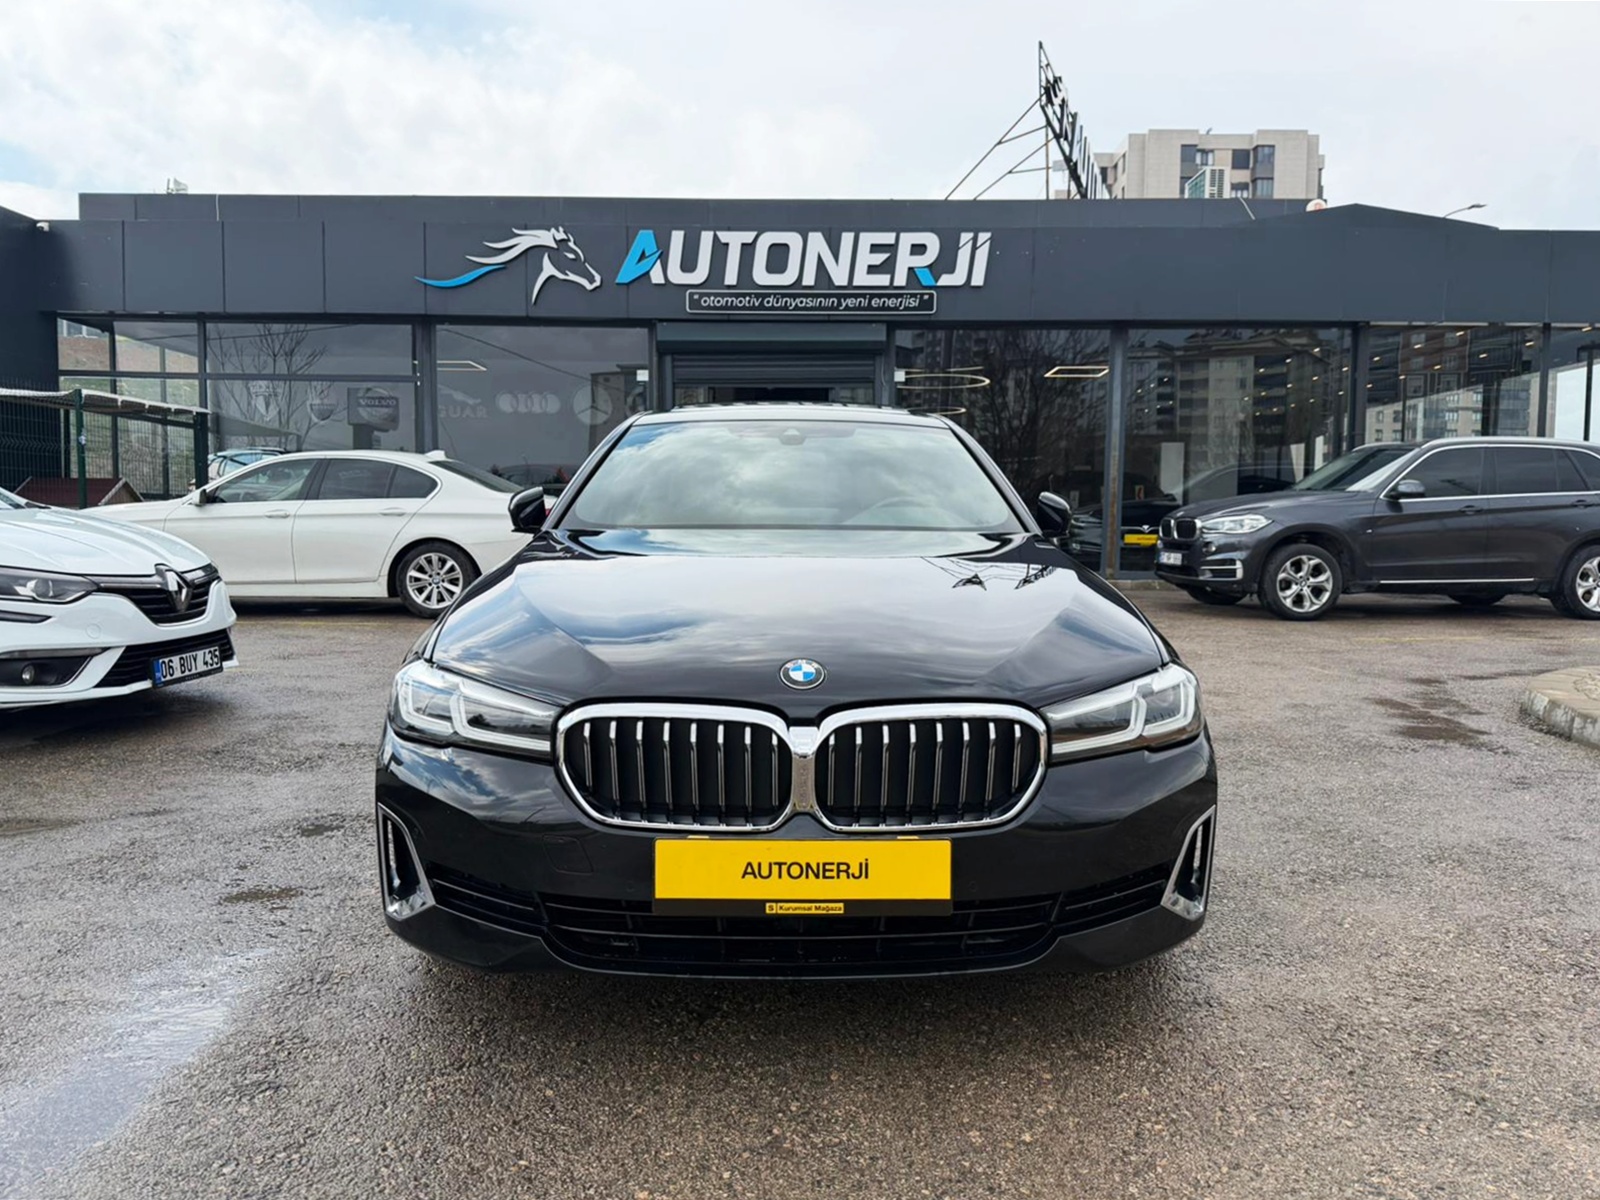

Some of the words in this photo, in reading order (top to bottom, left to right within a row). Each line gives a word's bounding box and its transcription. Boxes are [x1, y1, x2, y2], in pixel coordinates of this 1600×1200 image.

[700, 294, 762, 307] otomotiv
[764, 294, 838, 310] dünyasının
[839, 294, 869, 310] yeni
[871, 294, 920, 310] enerjisi
[359, 397, 397, 406] VOLVO
[160, 659, 175, 679] 06
[178, 653, 198, 675] BUY
[202, 648, 220, 668] 435
[741, 858, 869, 880] AUTONERJİ
[778, 904, 813, 912] Kurumsal
[814, 904, 842, 913] Mağaza
